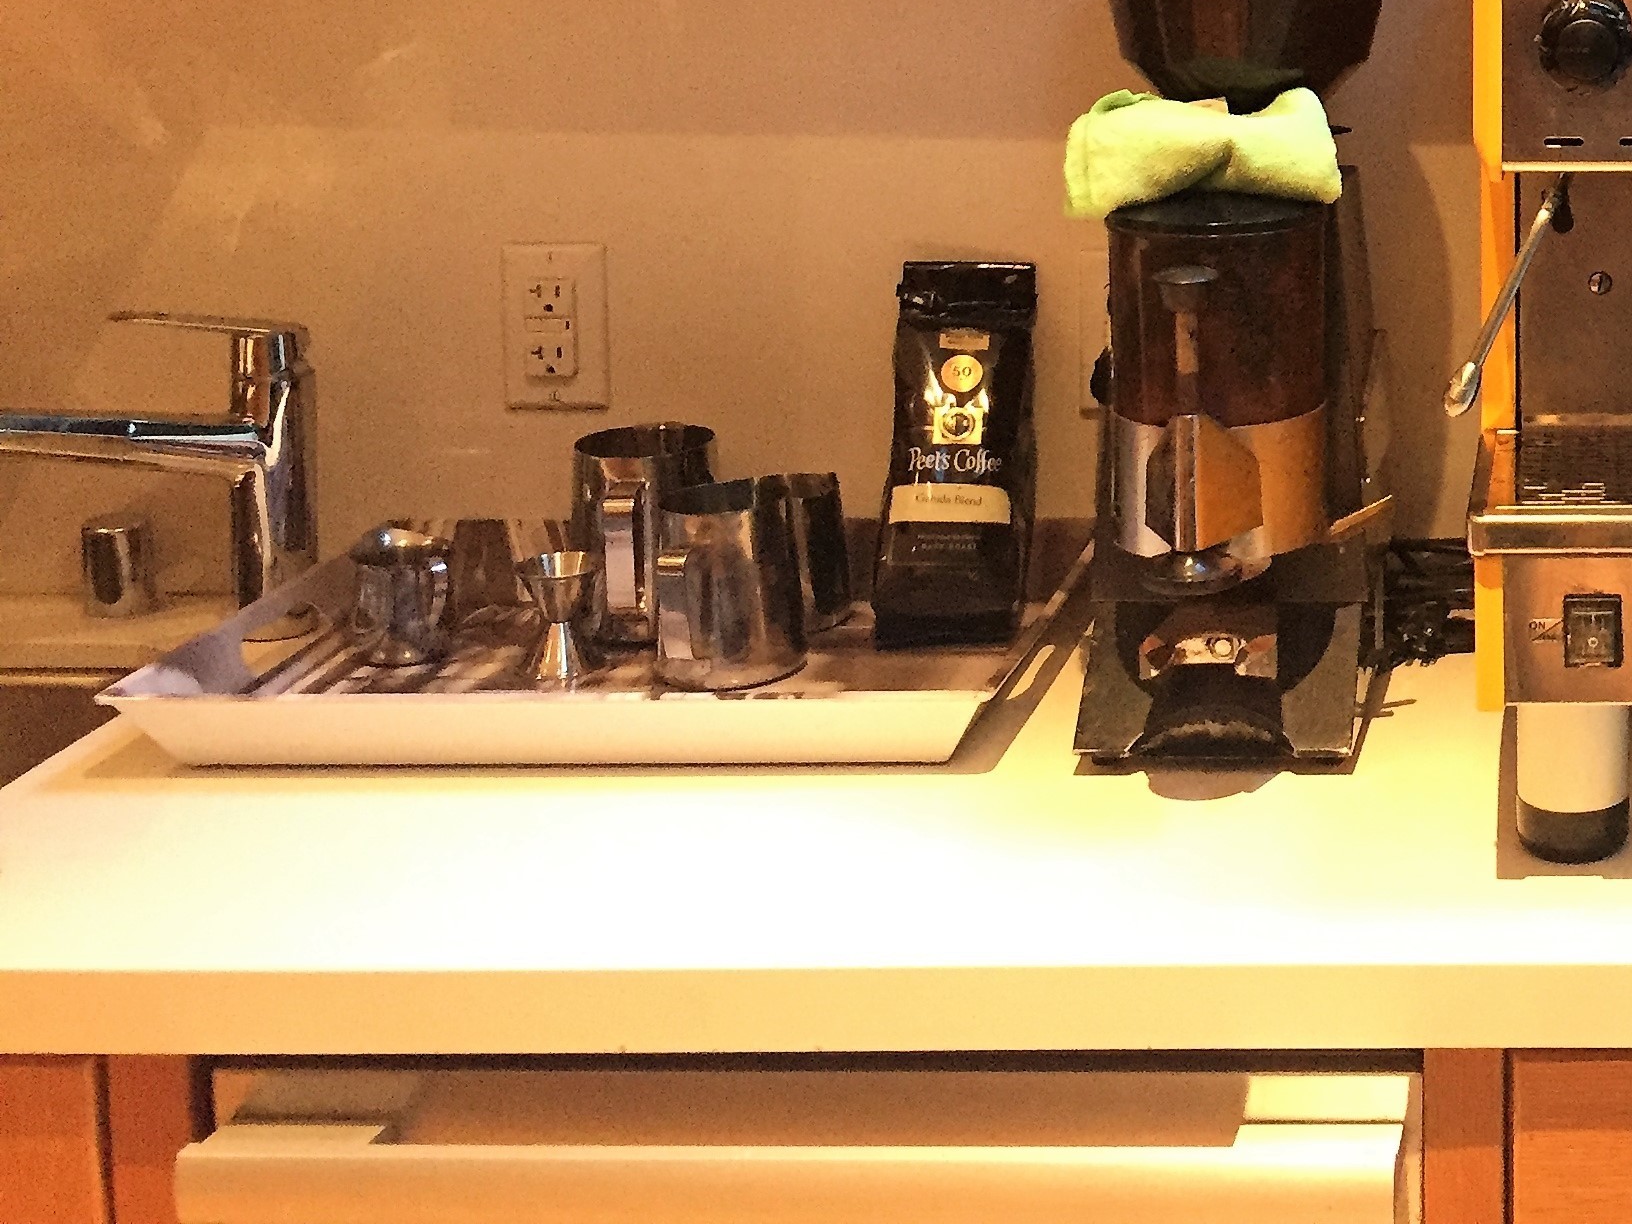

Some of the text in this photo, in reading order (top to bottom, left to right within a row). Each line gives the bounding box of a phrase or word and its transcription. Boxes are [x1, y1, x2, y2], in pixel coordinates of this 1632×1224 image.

[951, 366, 972, 377] 50
[954, 448, 1002, 474] Coffee
[1529, 621, 1546, 630] ON
